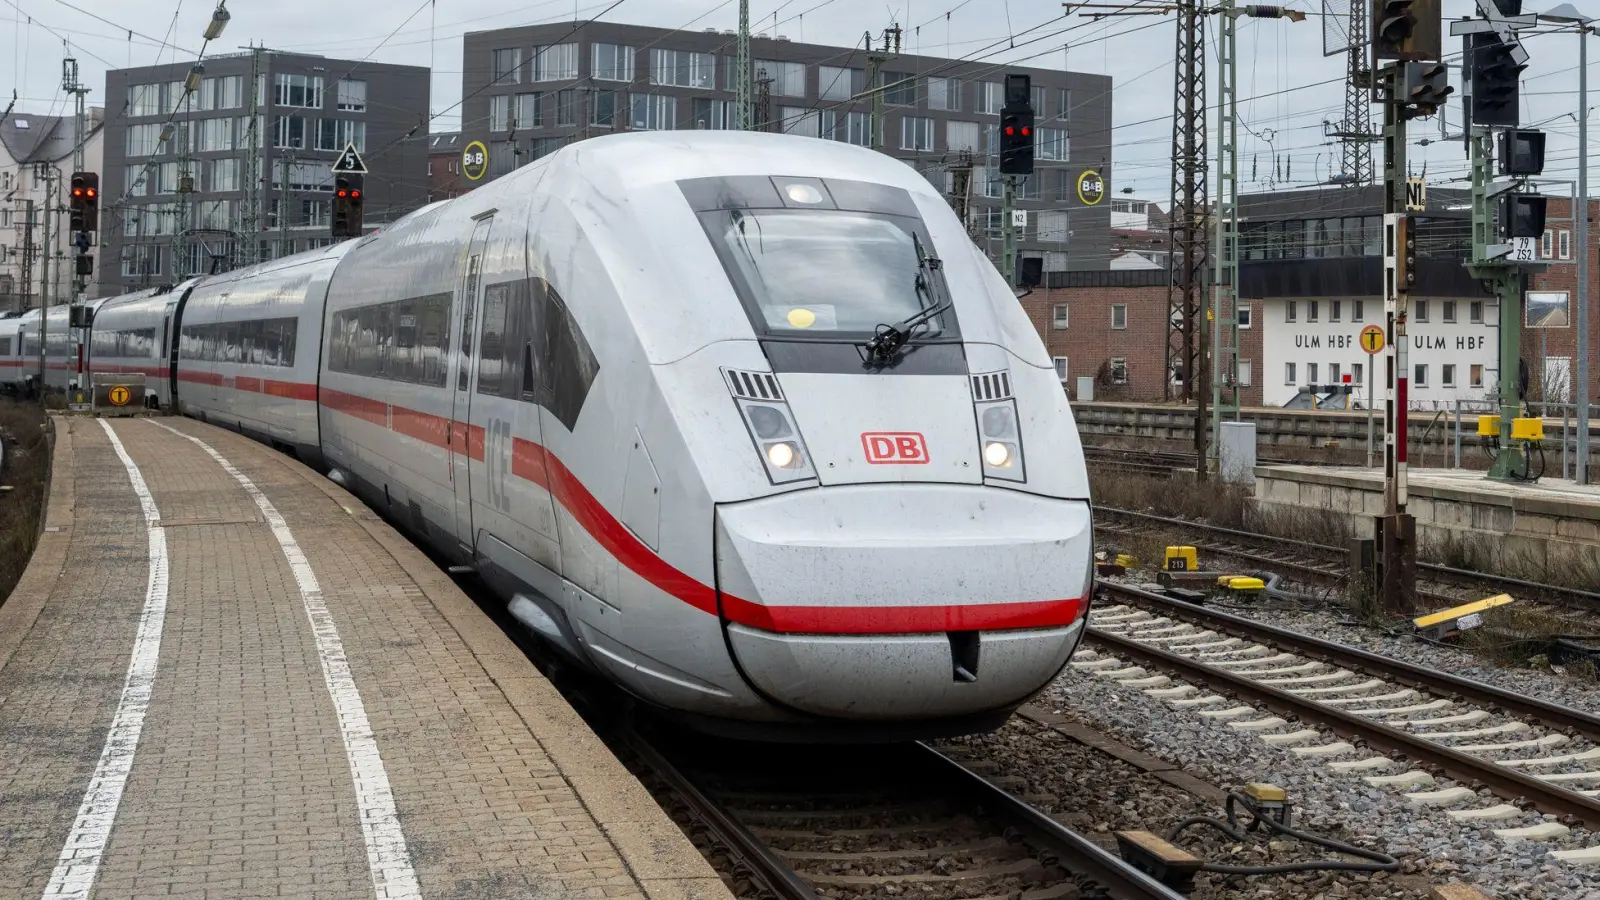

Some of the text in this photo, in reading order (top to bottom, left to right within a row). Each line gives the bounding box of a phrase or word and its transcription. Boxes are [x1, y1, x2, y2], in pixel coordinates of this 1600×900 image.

[345, 152, 355, 169] 5
[464, 153, 484, 165] B&B
[1082, 181, 1102, 192] B&B
[1015, 214, 1024, 222] N2
[1520, 237, 1529, 248] 79
[1295, 334, 1352, 348] ULM HBF
[1415, 335, 1485, 349] ULM HBF
[867, 435, 922, 460] DB
[487, 417, 510, 513] ICE
[1172, 560, 1184, 569] 213
